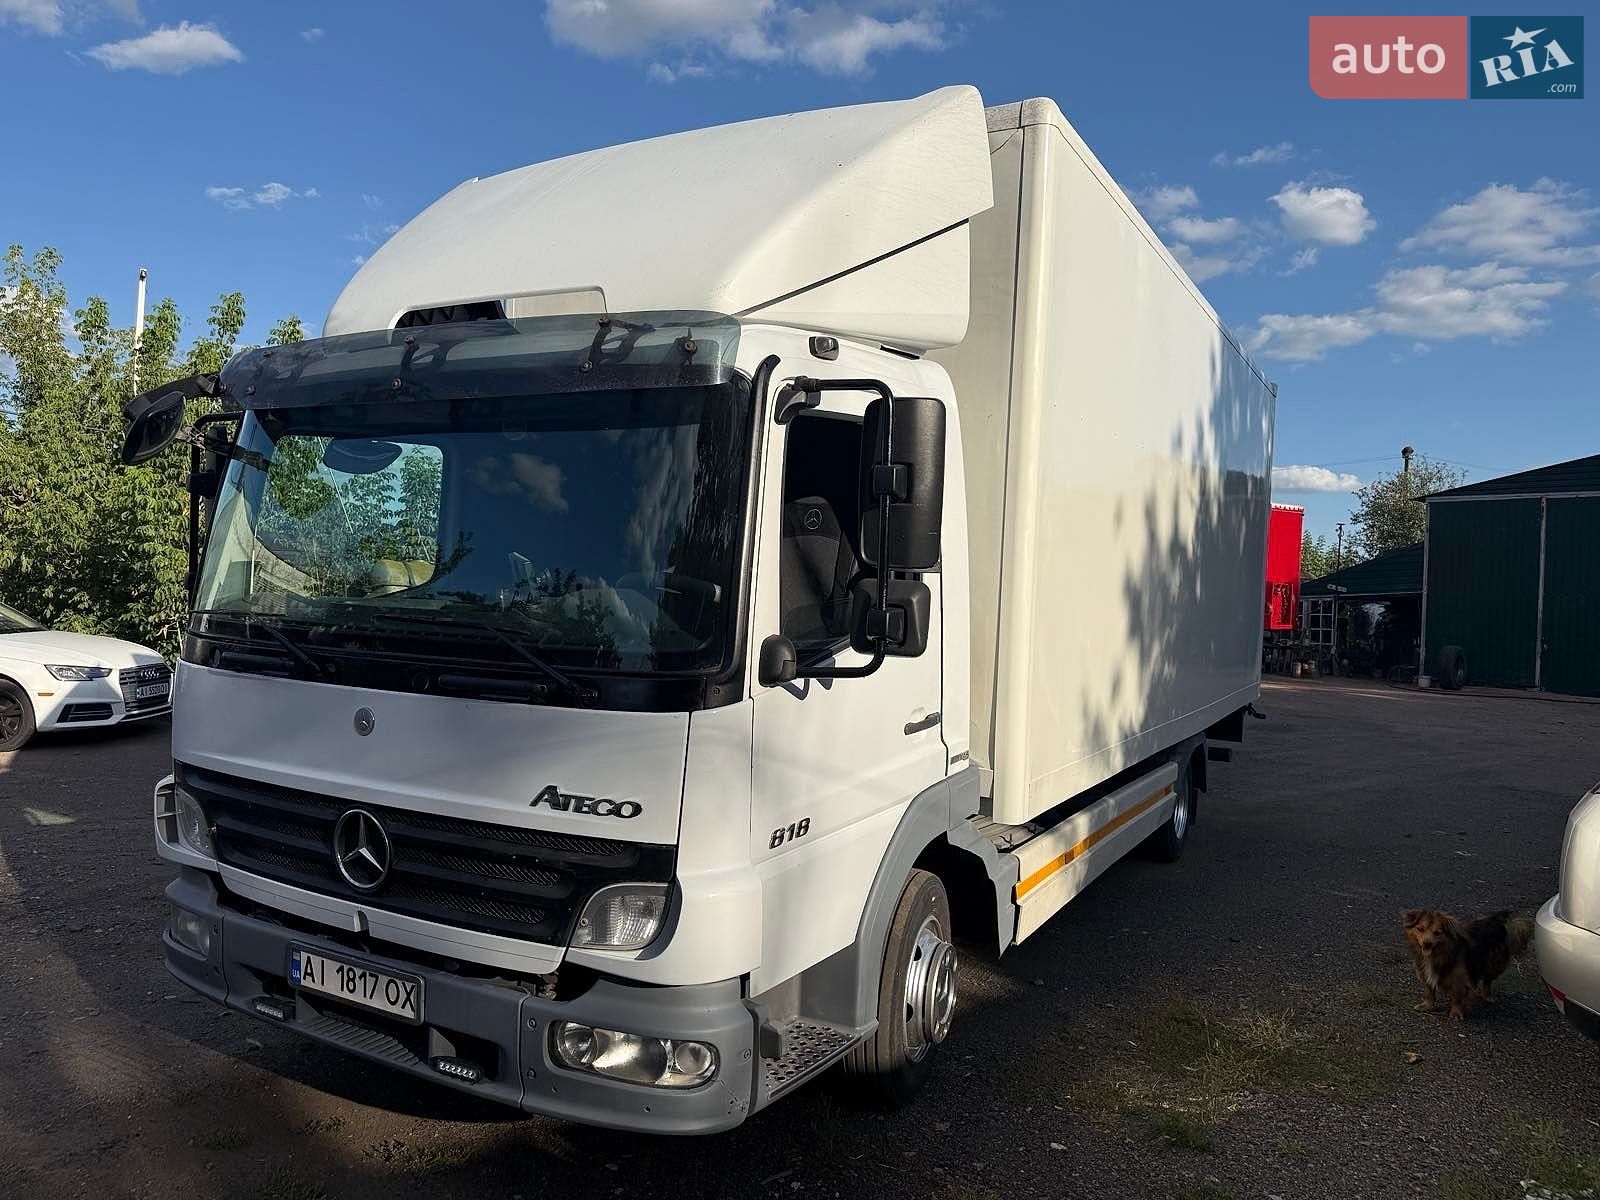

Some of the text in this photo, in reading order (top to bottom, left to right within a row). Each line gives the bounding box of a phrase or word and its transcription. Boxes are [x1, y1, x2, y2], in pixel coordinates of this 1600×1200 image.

[769, 817, 811, 849] 818
[292, 968, 300, 978] UA
[302, 955, 416, 1013] AI 1817 OX
